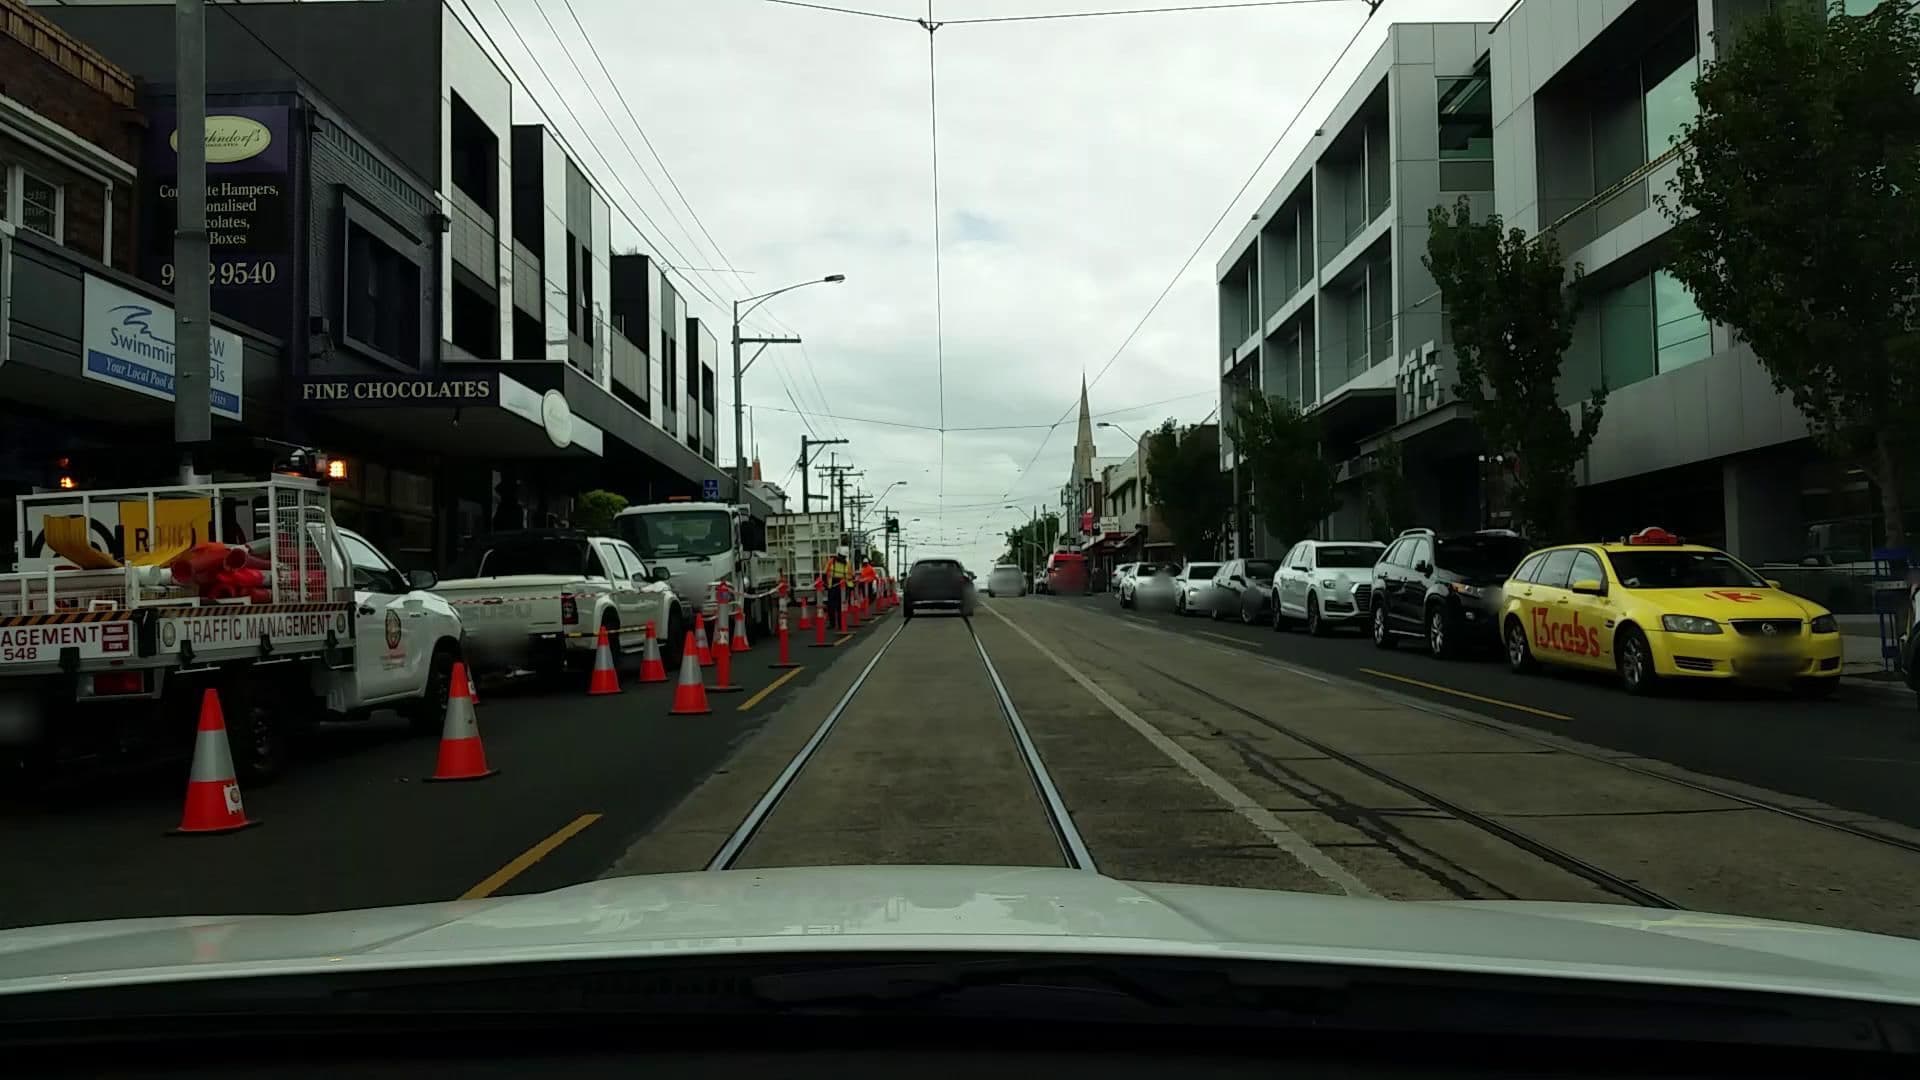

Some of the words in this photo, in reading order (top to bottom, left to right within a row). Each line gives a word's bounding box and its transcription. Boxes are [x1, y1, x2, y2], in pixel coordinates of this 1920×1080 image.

[221, 182, 279, 198] Hampers,
[209, 231, 247, 245] Boxes
[220, 261, 276, 285] 9540
[105, 356, 126, 375] Your
[127, 363, 149, 383] Local
[150, 371, 168, 387] Pool
[303, 383, 349, 400] FINE
[353, 380, 490, 400] CHOCOLATES
[1, 626, 99, 647] AGEMENT
[183, 618, 242, 643] TRAFFIC
[247, 614, 333, 640] MANAGEMENT
[1531, 607, 1600, 657] 13cabs
[4, 648, 37, 661] 548
